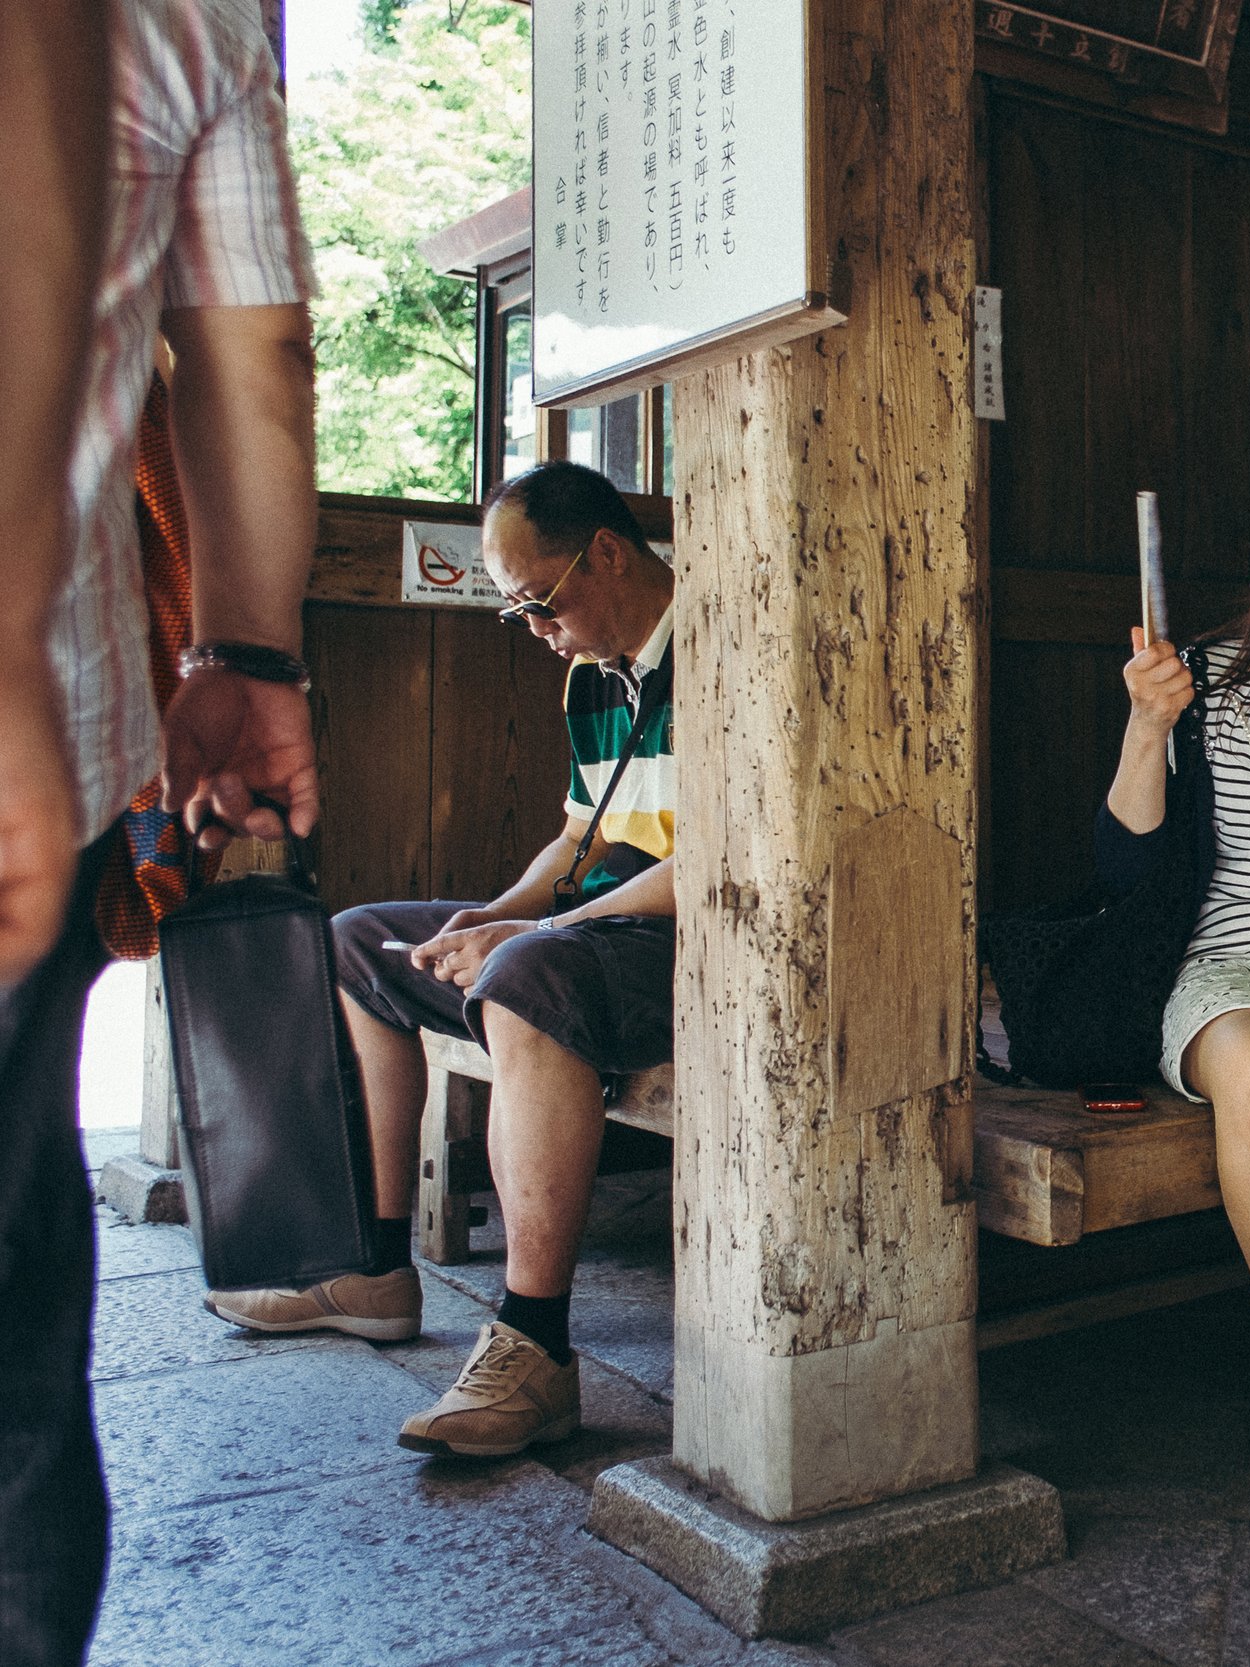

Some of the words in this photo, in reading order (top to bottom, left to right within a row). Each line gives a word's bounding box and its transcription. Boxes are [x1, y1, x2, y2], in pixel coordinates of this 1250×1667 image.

[719, 0, 737, 255] 、創建以来一度も
[431, 586, 464, 595] smoking
